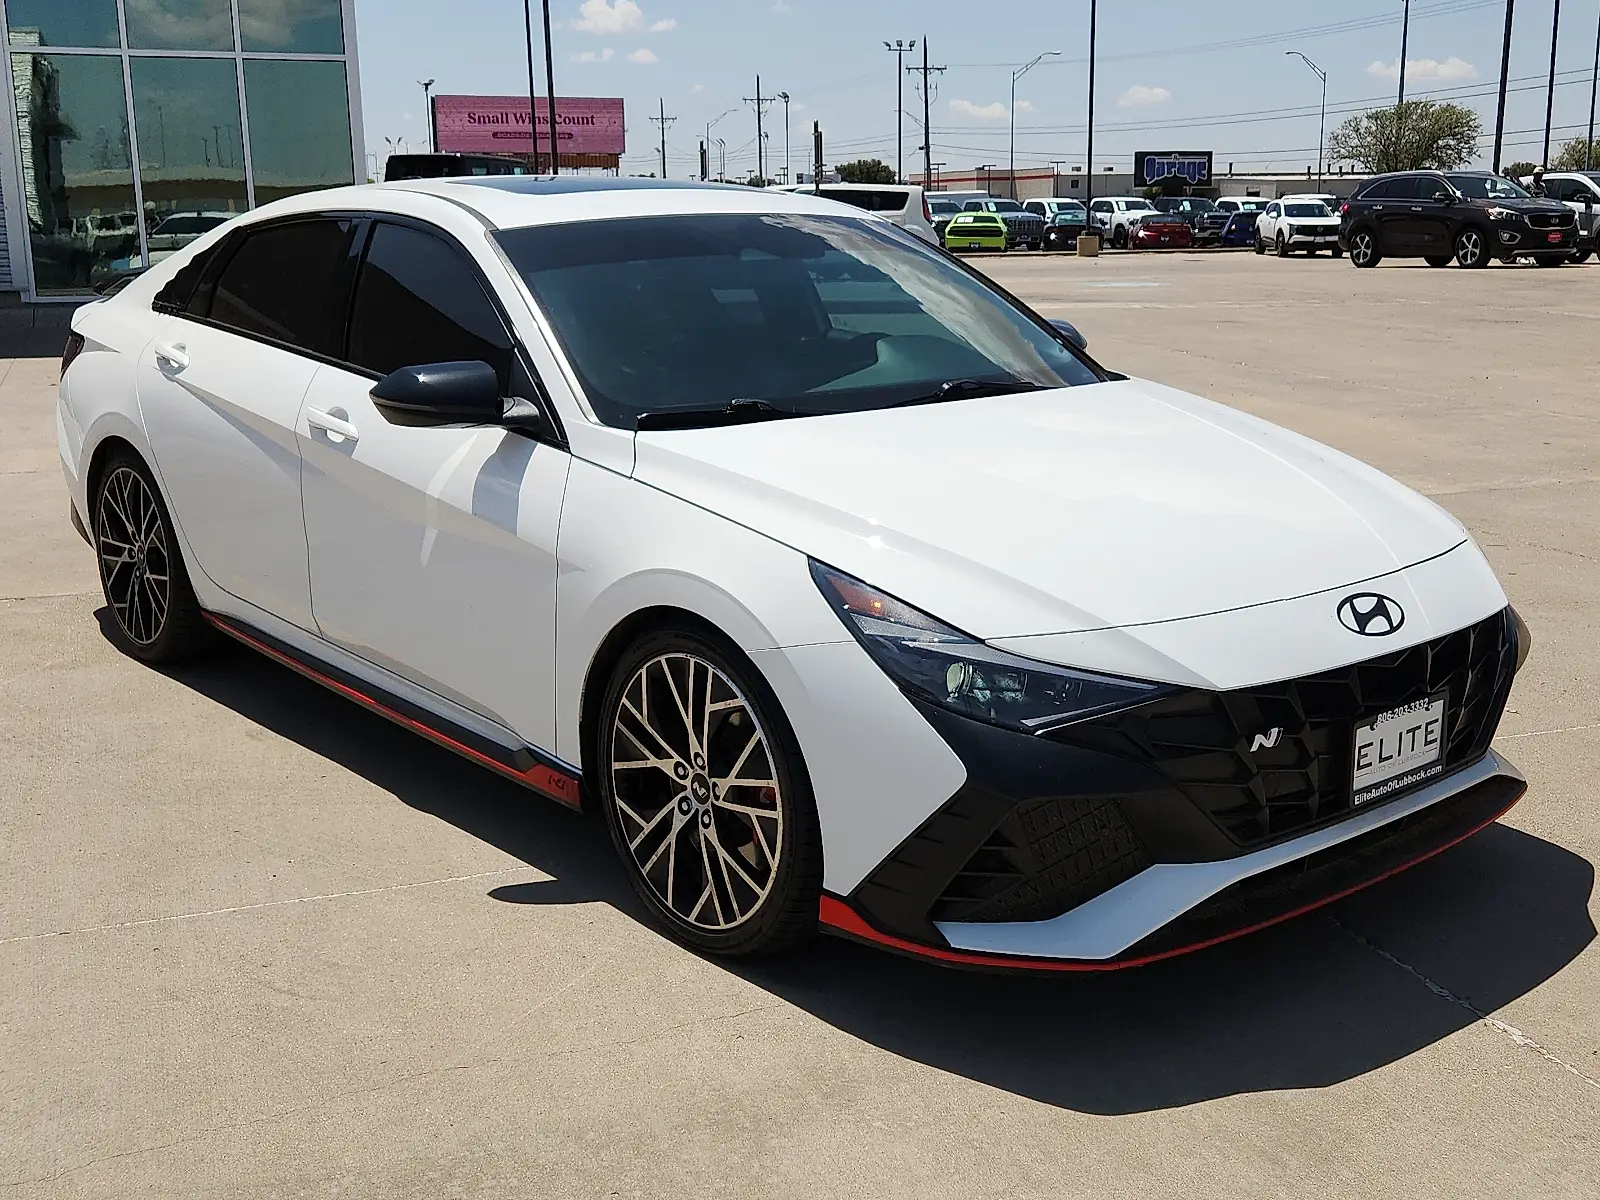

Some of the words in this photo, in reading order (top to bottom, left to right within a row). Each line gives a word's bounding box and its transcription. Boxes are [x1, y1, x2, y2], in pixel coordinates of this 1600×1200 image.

[467, 112, 510, 124] Small
[512, 112, 549, 125] Wins
[553, 113, 595, 126] Count
[1356, 717, 1440, 772] ELITE
[1354, 765, 1443, 805] EliteAutoOfLubbock.com
